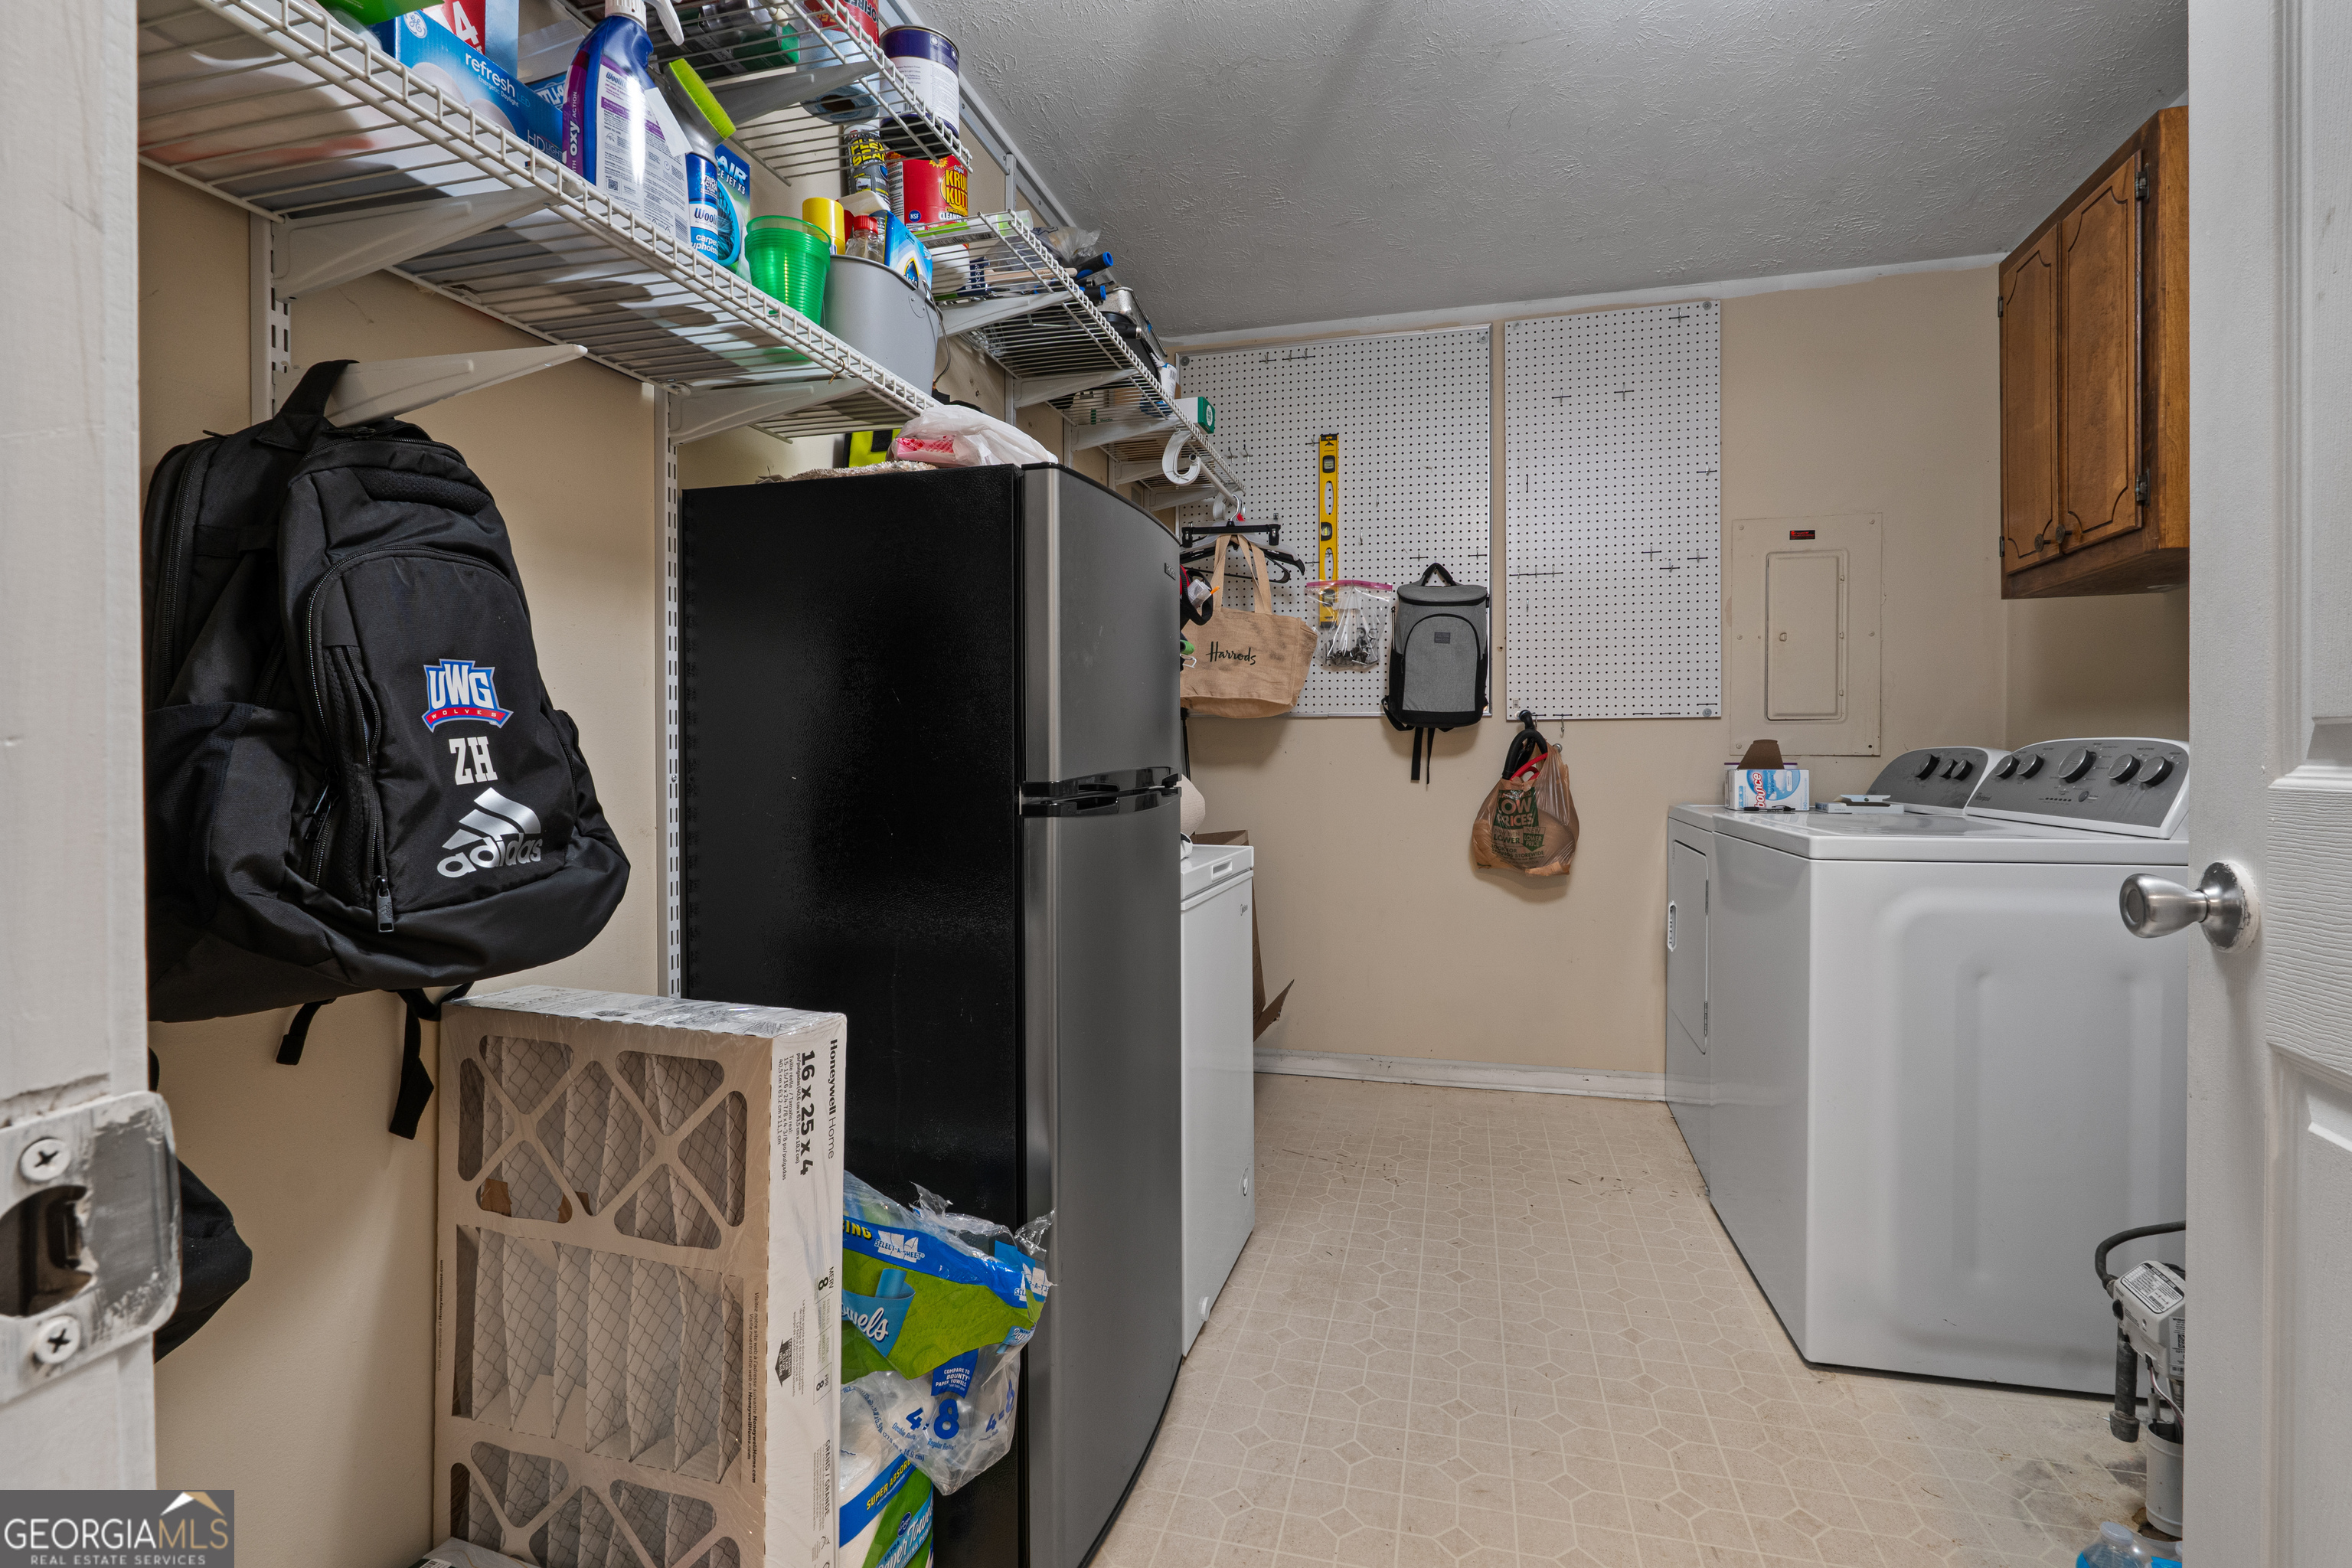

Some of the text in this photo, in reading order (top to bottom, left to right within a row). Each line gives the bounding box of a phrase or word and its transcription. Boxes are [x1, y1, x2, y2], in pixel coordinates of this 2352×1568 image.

[466, 53, 515, 97] refresh
[517, 93, 531, 108] LED
[478, 75, 500, 94] Energetic
[501, 91, 519, 108] Daylight
[527, 129, 545, 152] HD
[570, 120, 580, 157] oxy
[717, 155, 746, 185] AIR
[946, 169, 968, 190] KRU
[727, 175, 746, 195] JET X3
[946, 187, 968, 209] KUTT
[1206, 641, 1256, 665] Harrods
[428, 664, 495, 710] UWG
[431, 709, 497, 720] WOLVES
[449, 736, 498, 786] ZH
[1753, 772, 1766, 808] bounce
[1498, 797, 1531, 815] OW
[1494, 834, 1520, 844] LOWER
[437, 832, 543, 878] adidas
[779, 1074, 782, 1086] cm
[778, 1102, 782, 1114] cm
[796, 1101, 800, 1110] cm
[828, 1039, 838, 1160] Honeywell Home
[800, 1050, 815, 1176] 16 x 25 x 4
[777, 1135, 782, 1145] cm
[796, 1127, 800, 1135] cm
[818, 1276, 828, 1291] 8
[816, 1380, 825, 1392] 8
[906, 1407, 923, 1431] 4
[933, 1398, 960, 1440] 8
[891, 1423, 906, 1438] Double
[927, 1439, 942, 1449] Regular
[866, 1484, 889, 1511] SUPER
[884, 1540, 900, 1562] ULTRA
